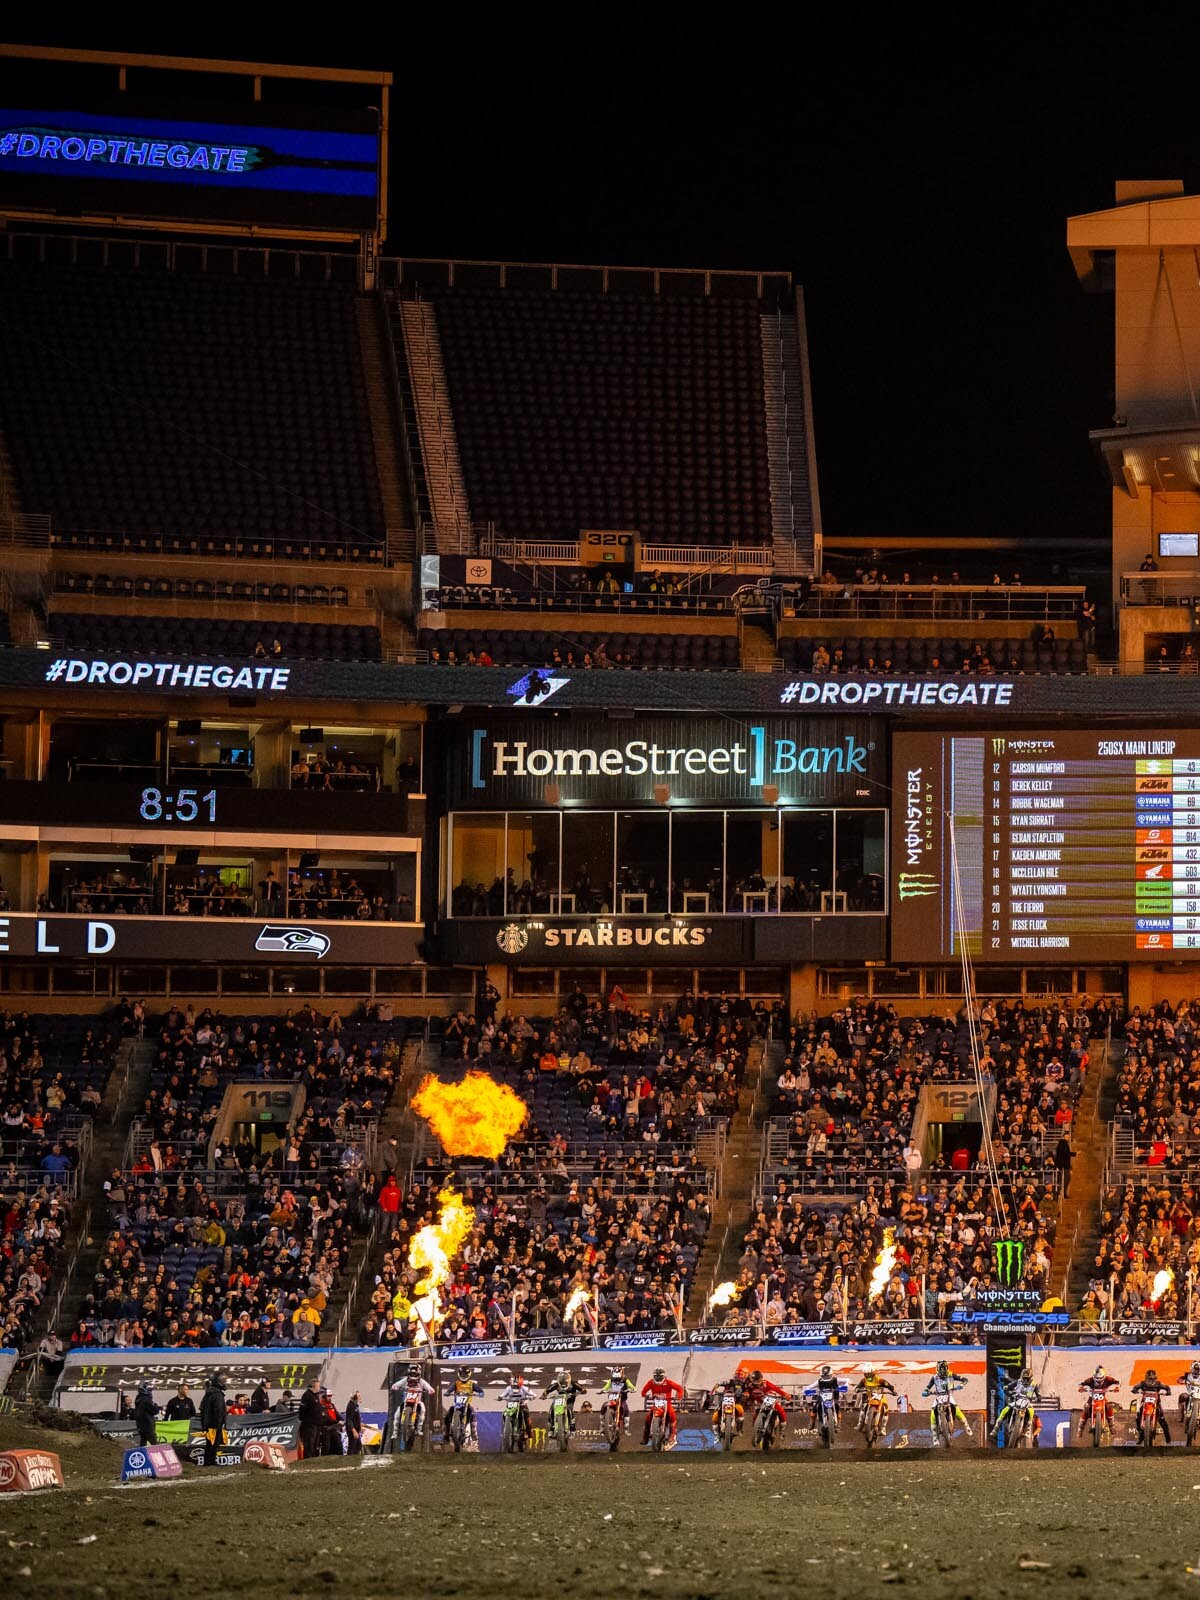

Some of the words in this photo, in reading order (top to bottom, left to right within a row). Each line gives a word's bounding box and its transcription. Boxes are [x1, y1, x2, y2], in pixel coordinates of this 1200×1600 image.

[0, 133, 248, 172] #DROPTHEGATE
[587, 533, 633, 546] 320
[45, 659, 291, 690] #DROPTHEGATE
[780, 681, 1013, 707] #DROPTHEGATE
[1008, 740, 1055, 749] MONSTER
[1098, 741, 1123, 755] 250SX
[1125, 741, 1146, 755] MAIN
[1148, 741, 1176, 755] LINEUP
[993, 763, 1000, 773] 12
[1012, 762, 1035, 773] CARSON
[993, 781, 1000, 791] 13
[1032, 780, 1053, 791] KELLEY
[1187, 779, 1196, 790] 74
[140, 787, 217, 822] 8:51
[993, 799, 1000, 809] 14
[905, 768, 922, 864] MONSTER
[993, 816, 1000, 826] 15
[1012, 815, 1028, 826] RYAN
[993, 834, 1000, 843] 16
[993, 851, 1000, 861] 17
[1035, 850, 1062, 861] AMERINE
[1185, 849, 1197, 859] 432
[993, 868, 1000, 878] 18
[1185, 866, 1197, 877] 503
[993, 885, 1000, 895] 19
[1012, 884, 1033, 895] WYATT
[1187, 884, 1196, 894] 181
[992, 903, 1000, 913] 20
[1012, 902, 1022, 913] TRE
[1024, 902, 1044, 913] FIERRO
[1186, 901, 1197, 912] 158
[993, 921, 1000, 930] 21
[1012, 920, 1028, 930] JESSE
[1029, 920, 1048, 930] FLOCK
[545, 927, 705, 947] STARBUCKS
[992, 938, 1000, 948] 22
[1040, 937, 1070, 948] HARRISON
[1187, 936, 1196, 947] 64
[242, 1090, 291, 1107] 119
[935, 1091, 984, 1108] 121
[977, 1290, 1041, 1302] MONSTER
[951, 1312, 1071, 1324] SUPERCROSS
[983, 1324, 1037, 1333] Championship
[121, 1365, 266, 1373] MONSTER
[1093, 1393, 1104, 1401] 96
[241, 1425, 294, 1436] MOUNTAIN
[125, 1467, 152, 1478] YAMAHA
